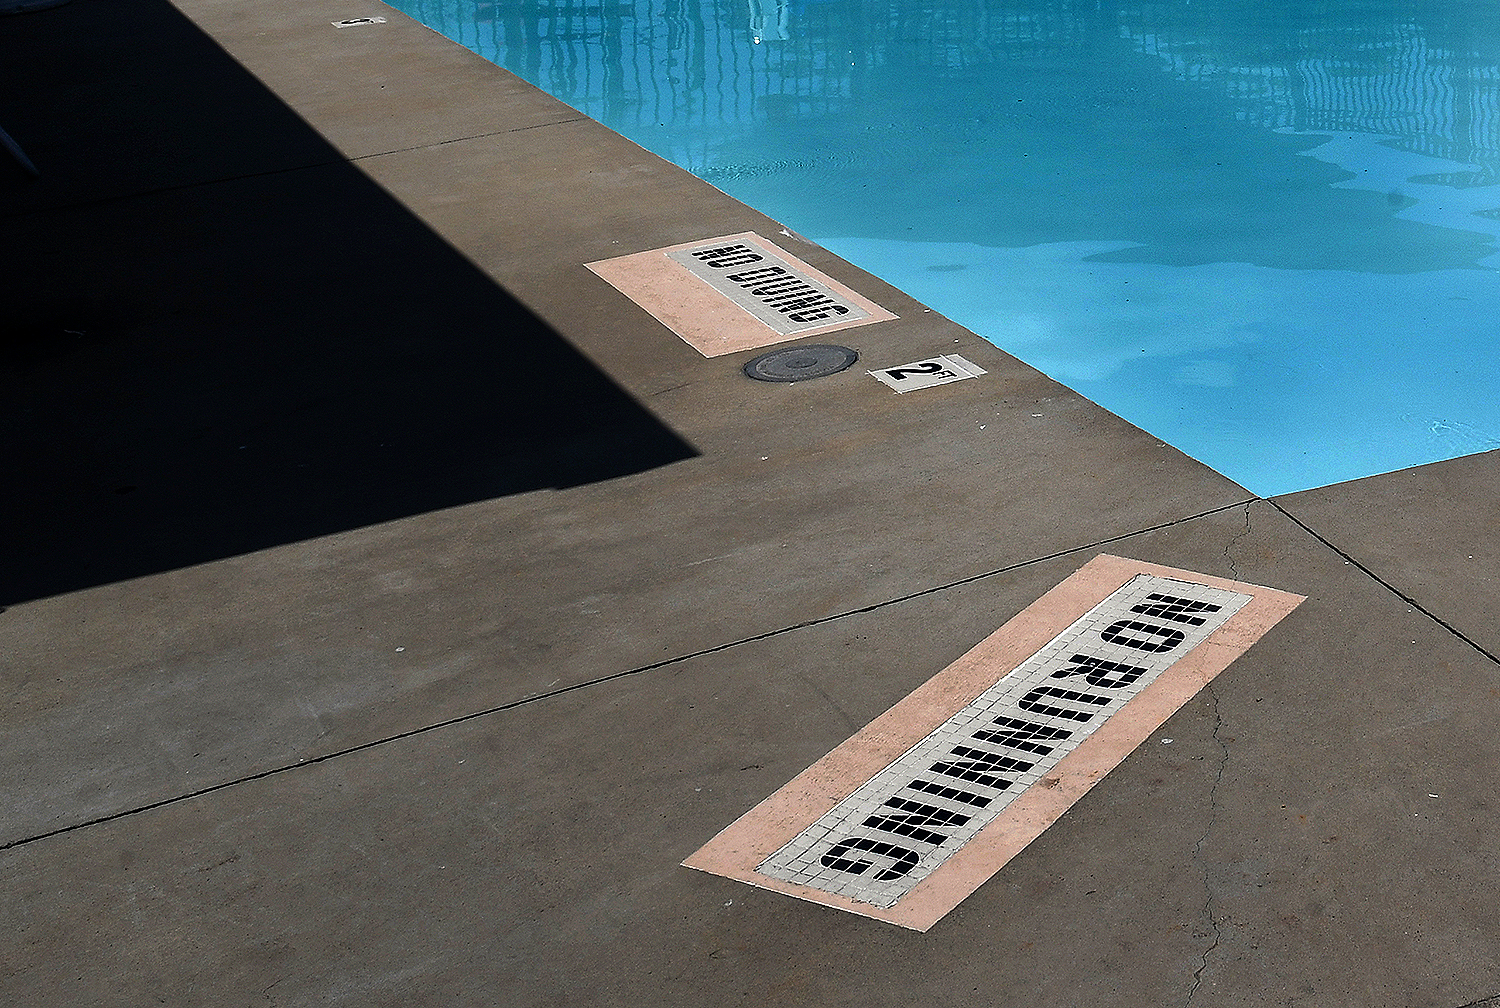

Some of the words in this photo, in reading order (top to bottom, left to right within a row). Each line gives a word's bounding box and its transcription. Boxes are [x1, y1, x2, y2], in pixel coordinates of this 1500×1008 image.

[691, 244, 763, 268] NO
[727, 266, 850, 323] DIVING
[884, 363, 943, 380] 2
[932, 367, 958, 381] FT
[1101, 593, 1222, 653] NO
[819, 654, 1148, 881] RUNNING
